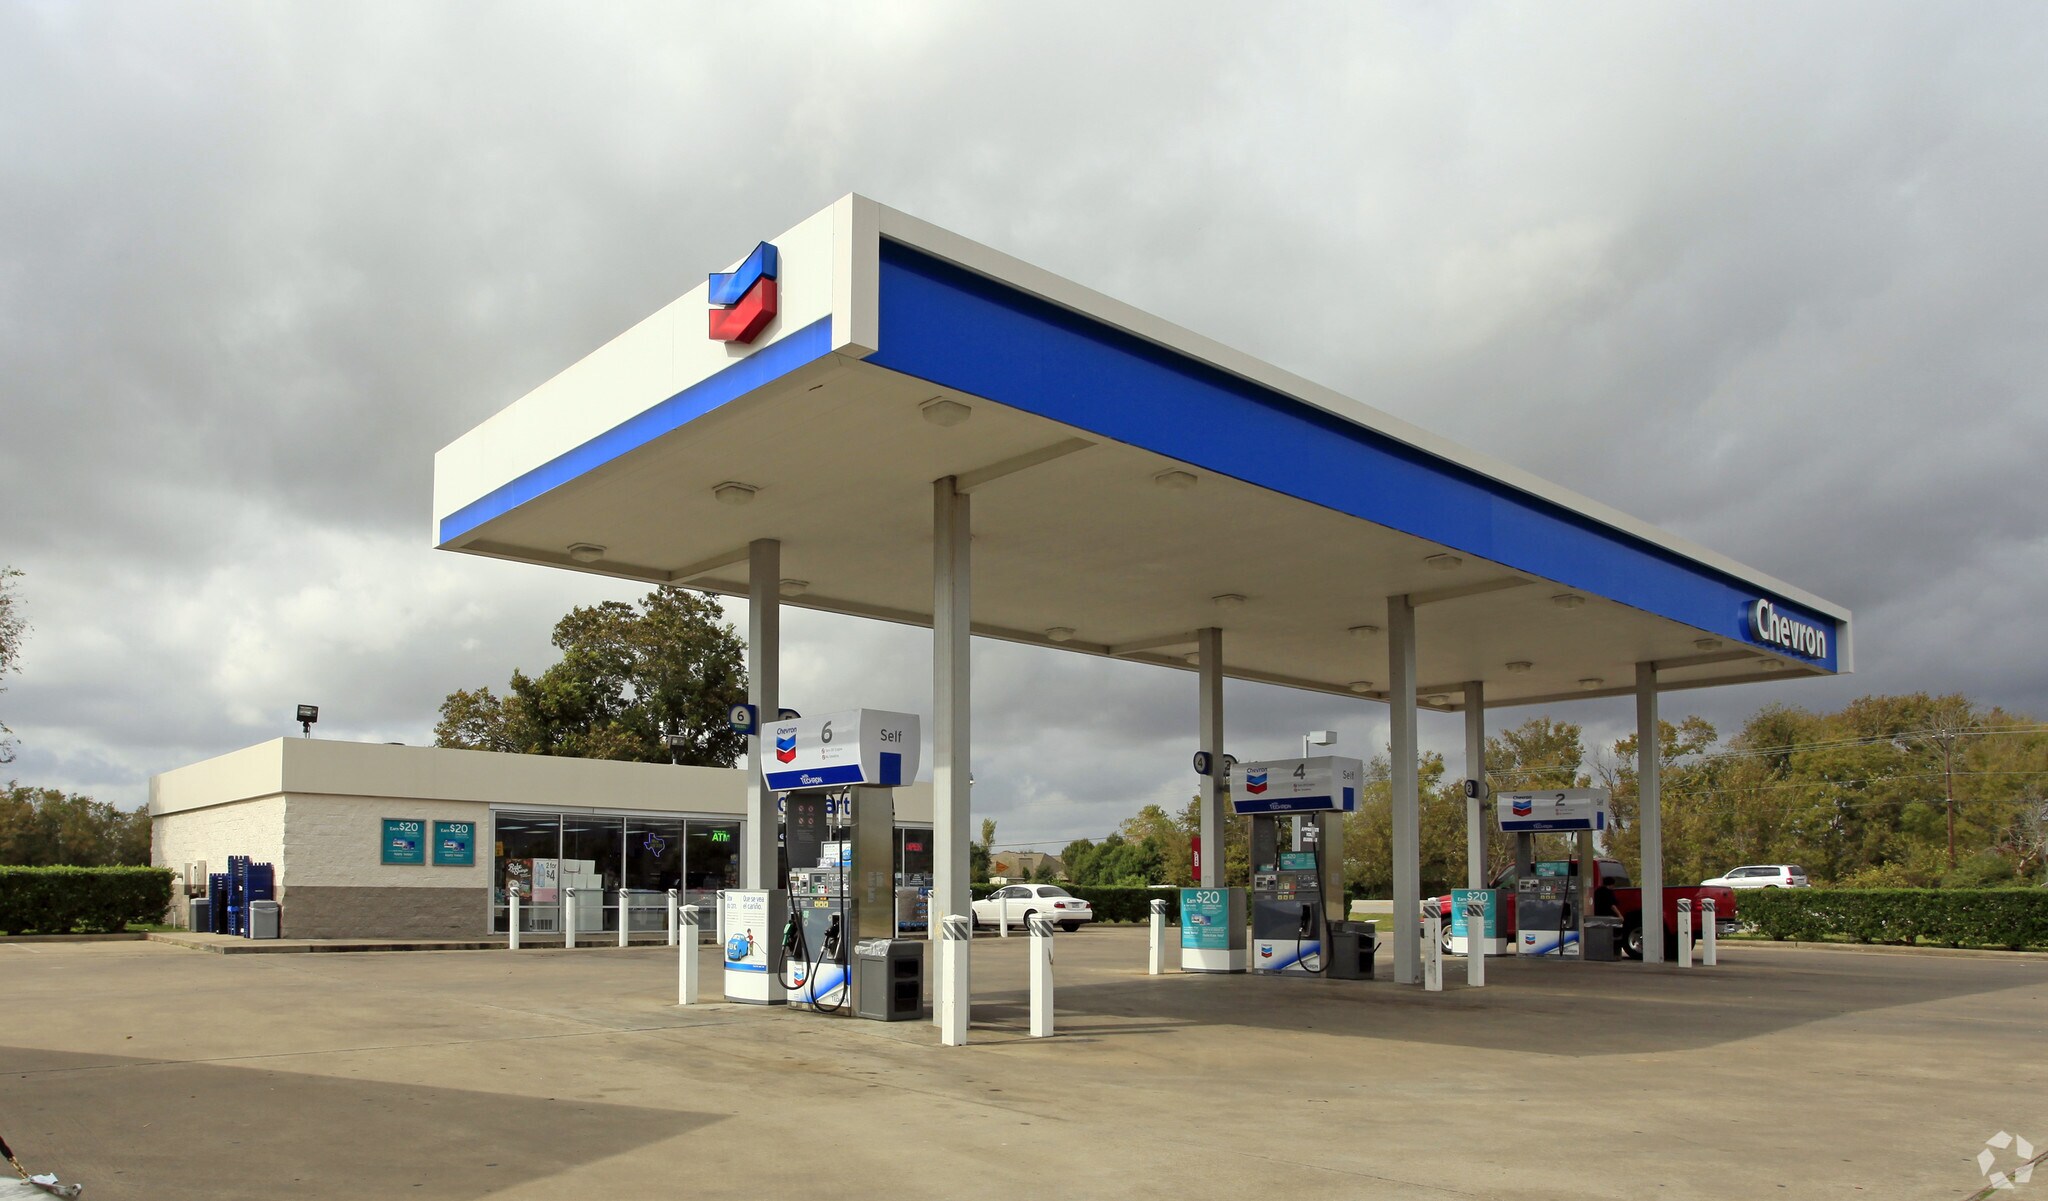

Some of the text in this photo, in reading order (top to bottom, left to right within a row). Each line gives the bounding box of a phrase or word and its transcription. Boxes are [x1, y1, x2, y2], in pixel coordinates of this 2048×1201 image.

[1756, 598, 1827, 659] Chevron
[737, 710, 745, 722] 6
[776, 727, 798, 735] Chevron
[820, 720, 833, 744] 6
[880, 728, 902, 744] Self
[1197, 758, 1203, 769] 4
[1293, 763, 1306, 780] 4
[1342, 770, 1355, 780] Self
[1467, 784, 1472, 793] 2
[1555, 793, 1566, 807] 2
[399, 822, 419, 832] $20
[450, 824, 468, 834] $20
[712, 832, 730, 842] ATM
[547, 870, 556, 882] $4
[1196, 891, 1220, 904] $20
[1467, 892, 1488, 901] $20
